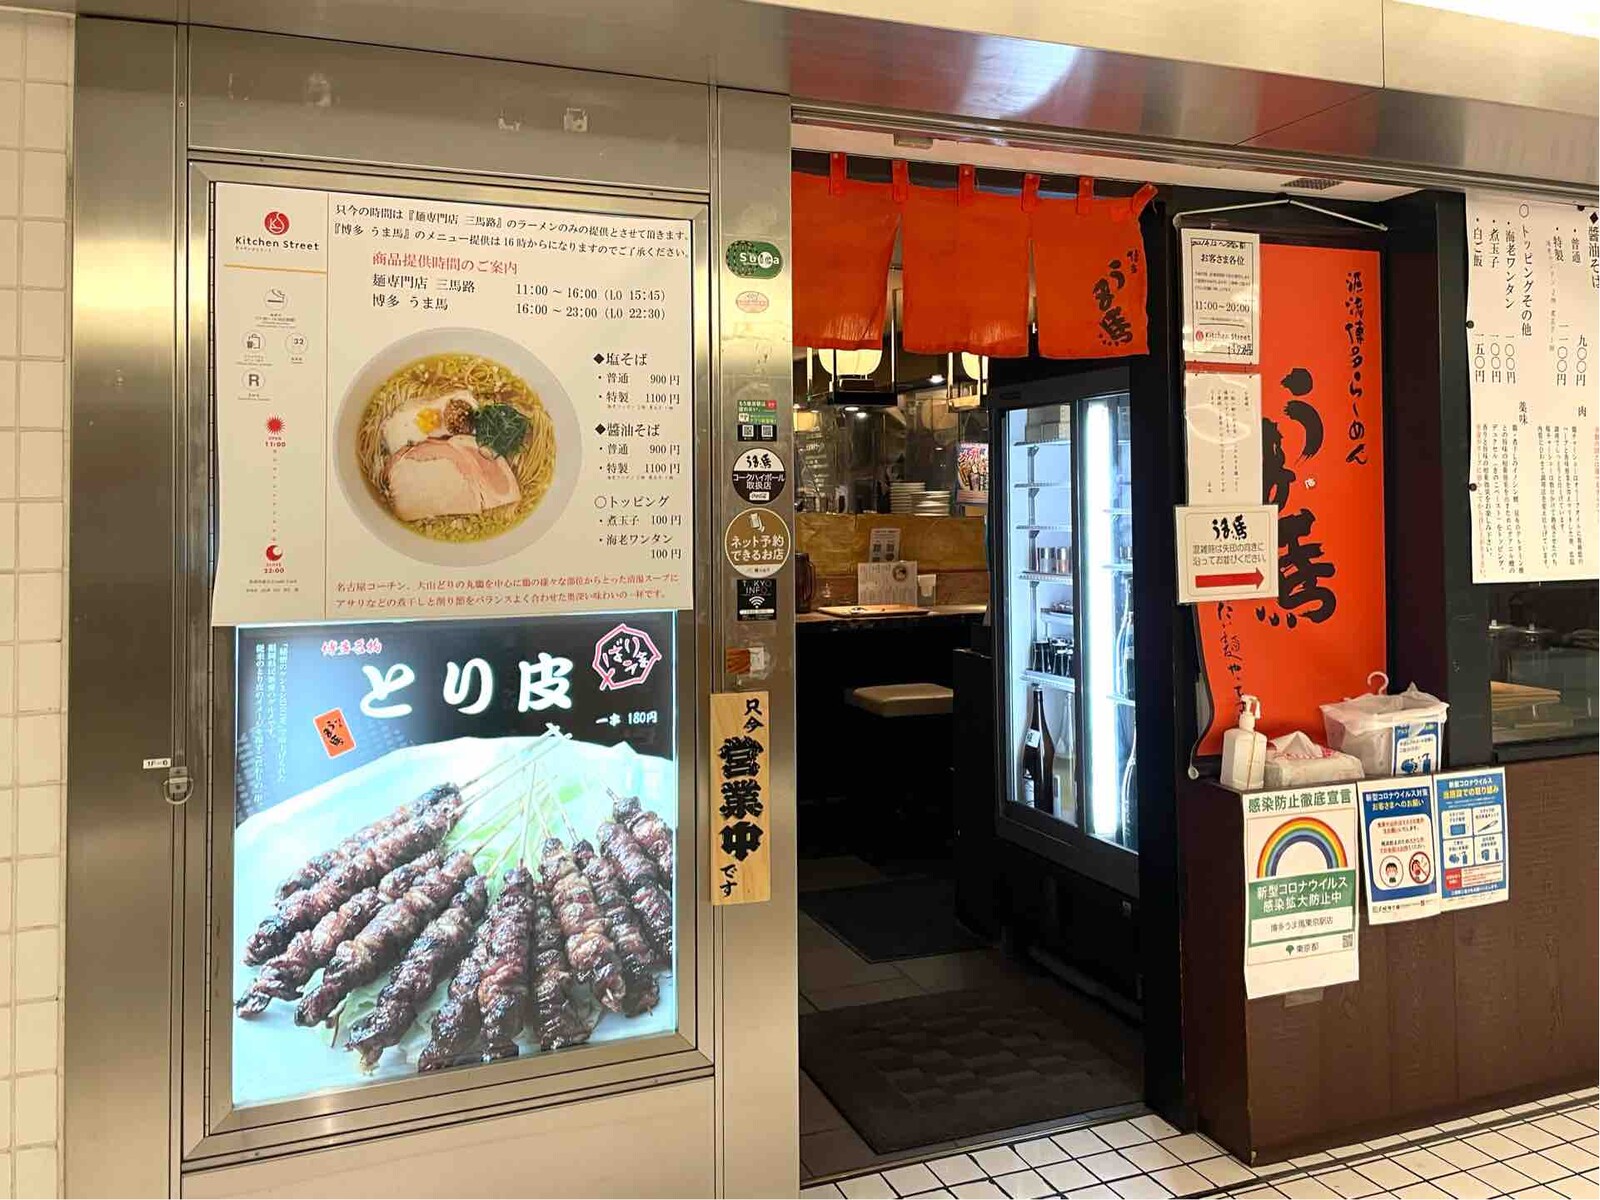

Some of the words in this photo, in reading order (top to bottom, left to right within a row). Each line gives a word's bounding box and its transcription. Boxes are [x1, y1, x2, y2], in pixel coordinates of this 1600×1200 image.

[235, 236, 280, 247] Kitchen
[282, 240, 320, 251] Street
[1473, 226, 1484, 268] 白ご飯
[1488, 227, 1501, 269] 煮玉子
[1552, 235, 1564, 262] 特製
[1571, 237, 1582, 264] 普通
[372, 250, 518, 275] 商品提供時間のご案内
[1200, 253, 1246, 266] お客さま各位
[1505, 228, 1517, 309] 海老ワンタン
[372, 273, 428, 291] 麺専門店
[436, 278, 476, 294] 三馬路
[1521, 223, 1535, 337] トッピングその他
[516, 283, 548, 297] 11:00
[567, 286, 597, 300] 16:00
[629, 289, 666, 302] 15:45)
[372, 293, 400, 308] 博多
[409, 295, 449, 312] うま馬
[516, 303, 548, 315] 16:00
[565, 306, 597, 319] 23:00
[628, 308, 666, 321] 22:30)
[606, 352, 648, 367] 塩そば
[606, 372, 629, 384] 普通
[649, 373, 680, 386] 900円
[606, 390, 629, 403] 特製
[645, 392, 680, 405] 1100円
[1518, 400, 1529, 426] 薬味
[1577, 405, 1588, 418] 肉
[607, 442, 629, 455] 普通
[649, 443, 680, 456] 900円
[606, 461, 629, 474] 特製
[645, 462, 681, 475] 1100円
[733, 473, 785, 482] コークハイボール
[746, 481, 772, 491] 取扱店
[610, 494, 670, 508] トッピング
[606, 514, 640, 526] 煮玉子
[651, 514, 682, 526] 100円
[606, 533, 674, 546] 海老ワンタン
[730, 535, 785, 549] ネット予約
[651, 548, 682, 560] 100円
[730, 548, 785, 562] できるお店
[1192, 542, 1265, 555] 混雑時は矢印の向きに
[360, 652, 574, 719] とり皮
[627, 710, 658, 725] 180円
[744, 698, 765, 734] 只今
[718, 735, 765, 862] 営業中
[1248, 788, 1353, 814] 感染防止徹底宣言
[1365, 787, 1429, 802] 新型コロナウイルス対策
[719, 863, 738, 898] です
[1257, 876, 1349, 901] 新型コロナウイルス
[1263, 890, 1343, 914] 感染拡大防止中
[1296, 941, 1320, 954] 東京都
